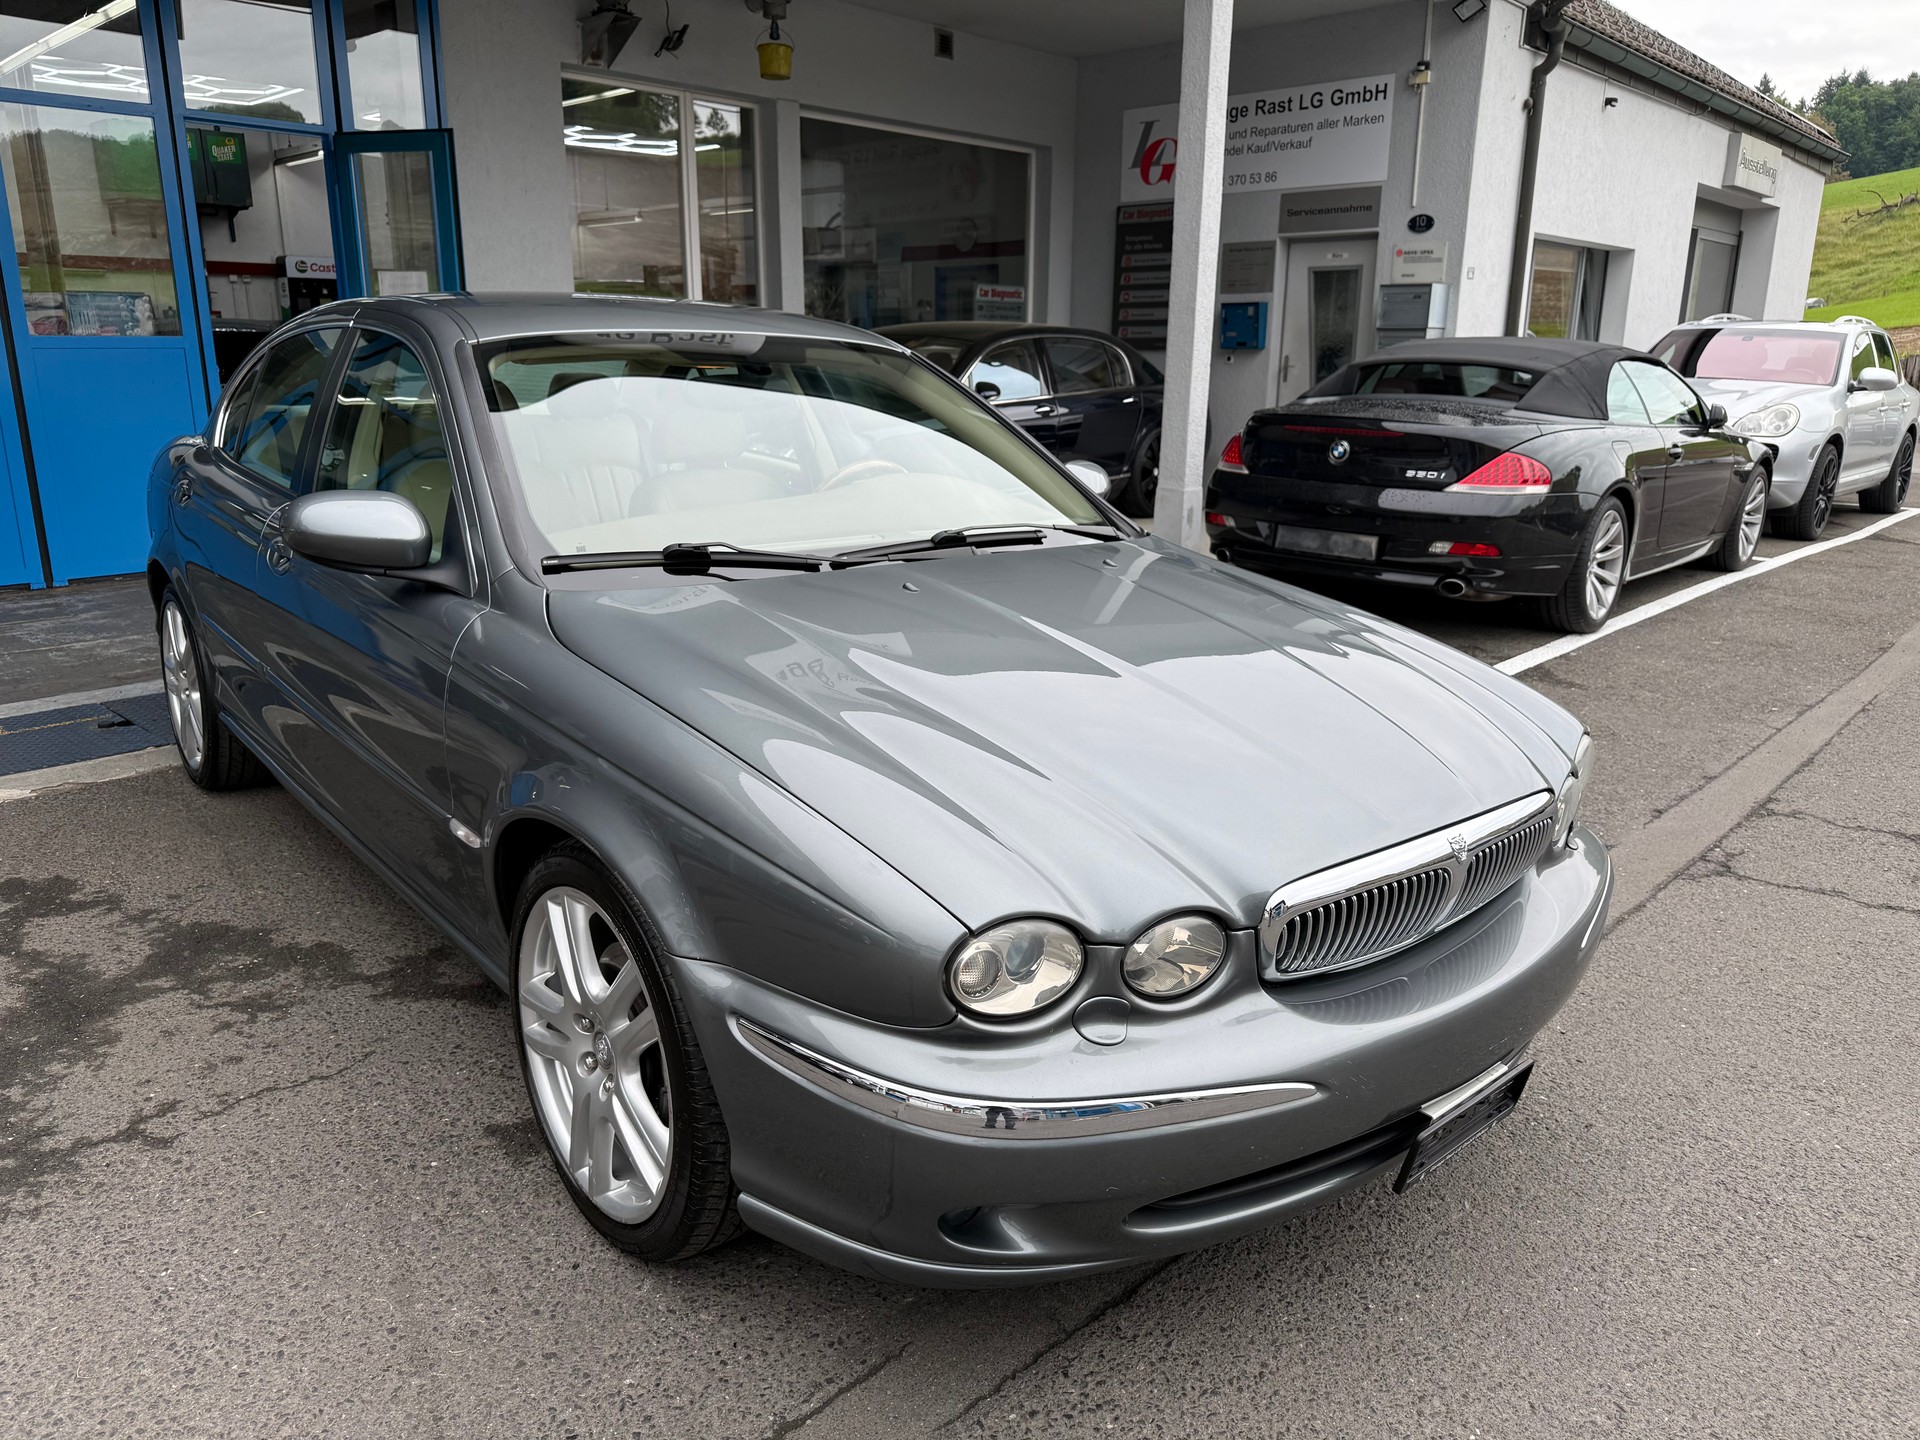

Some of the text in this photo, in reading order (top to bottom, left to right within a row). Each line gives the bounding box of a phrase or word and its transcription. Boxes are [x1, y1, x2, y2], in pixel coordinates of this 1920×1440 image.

[1254, 96, 1293, 116] Rast
[1299, 91, 1324, 111] LG
[1330, 83, 1388, 107] GmbH
[1229, 113, 1385, 140] und Reparaturen aller Marken
[1246, 136, 1314, 155] Kauf/Verkauf
[1228, 171, 1278, 187] 370 53 86
[1286, 204, 1373, 217] Serviceannahme
[1416, 216, 1427, 227] 10
[310, 262, 336, 273] Cast
